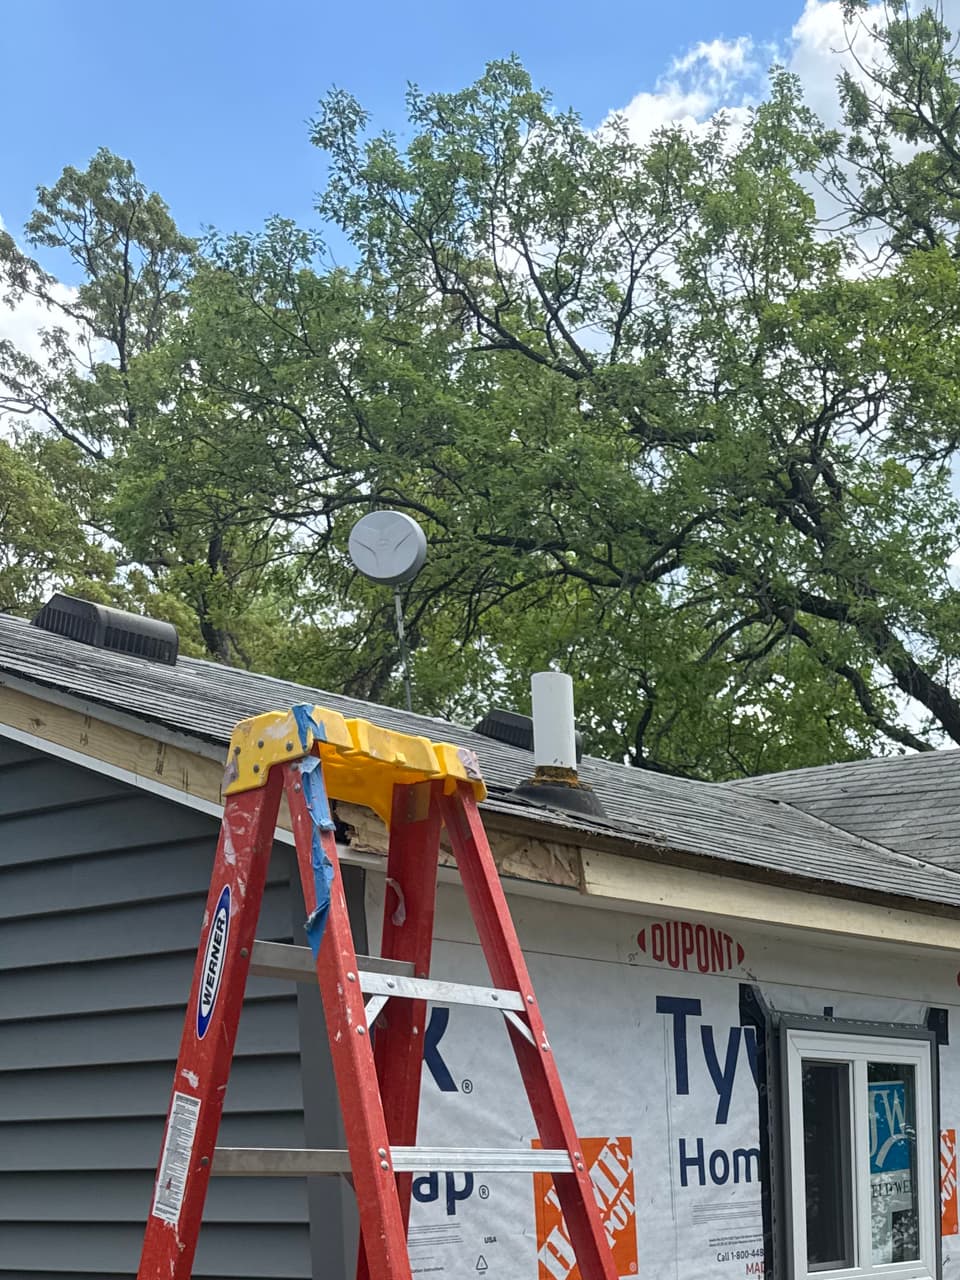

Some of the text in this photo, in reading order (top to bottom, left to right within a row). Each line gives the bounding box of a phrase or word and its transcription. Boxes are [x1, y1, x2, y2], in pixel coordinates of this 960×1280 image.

[203, 916, 225, 1007] WERNER
[651, 921, 734, 973] DUPONT
[717, 1252, 729, 1262] Call
[746, 1262, 765, 1275] MAD
